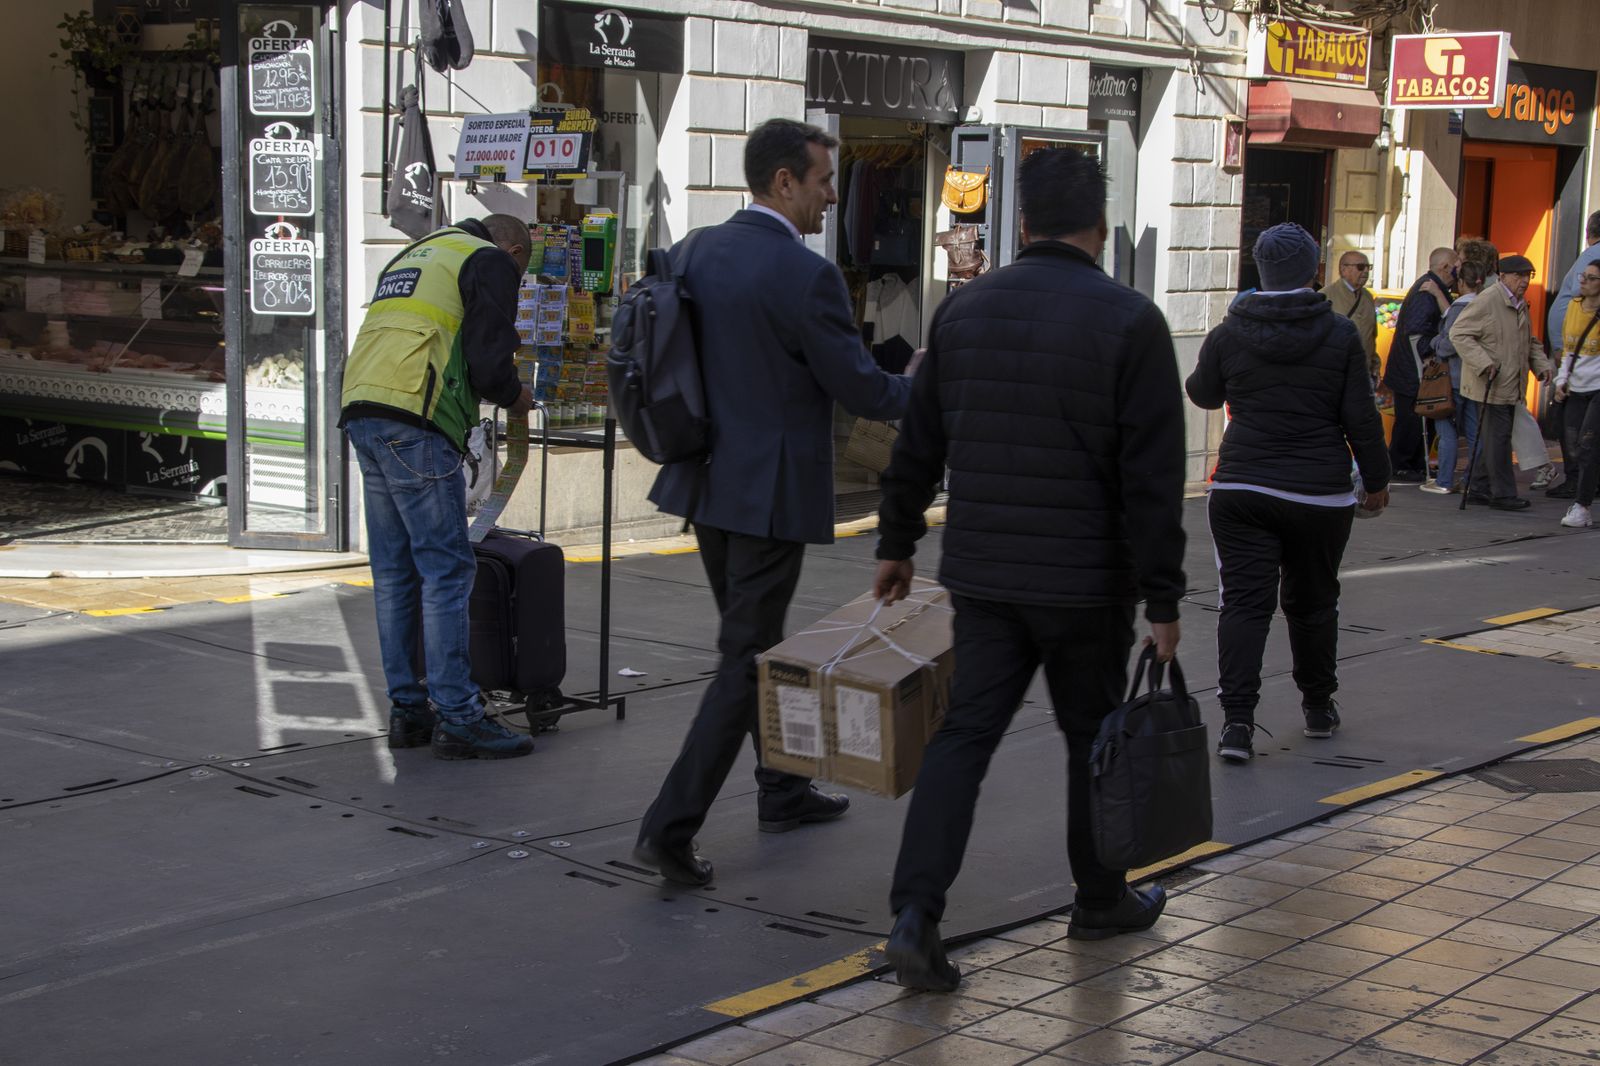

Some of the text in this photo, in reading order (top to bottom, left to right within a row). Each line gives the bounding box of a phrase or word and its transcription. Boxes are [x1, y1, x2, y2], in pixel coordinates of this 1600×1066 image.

[252, 39, 309, 51] OFERTA
[589, 42, 635, 58] La Serranía
[1297, 26, 1367, 68] TABACOS
[1396, 76, 1490, 96] TABACOS
[467, 120, 494, 130] SORTEO
[495, 118, 526, 129] ESPECIAL
[602, 111, 647, 125] OFERTA
[544, 125, 554, 133] DE
[556, 120, 593, 132] JACKPOT
[465, 133, 523, 144] DIA DE LA MADRE
[253, 141, 310, 153] OFERTA
[465, 149, 516, 161] 17.000.000 €
[253, 241, 310, 253] OFERTA
[378, 281, 413, 296] ONCE
[145, 459, 199, 484] La Serranía
